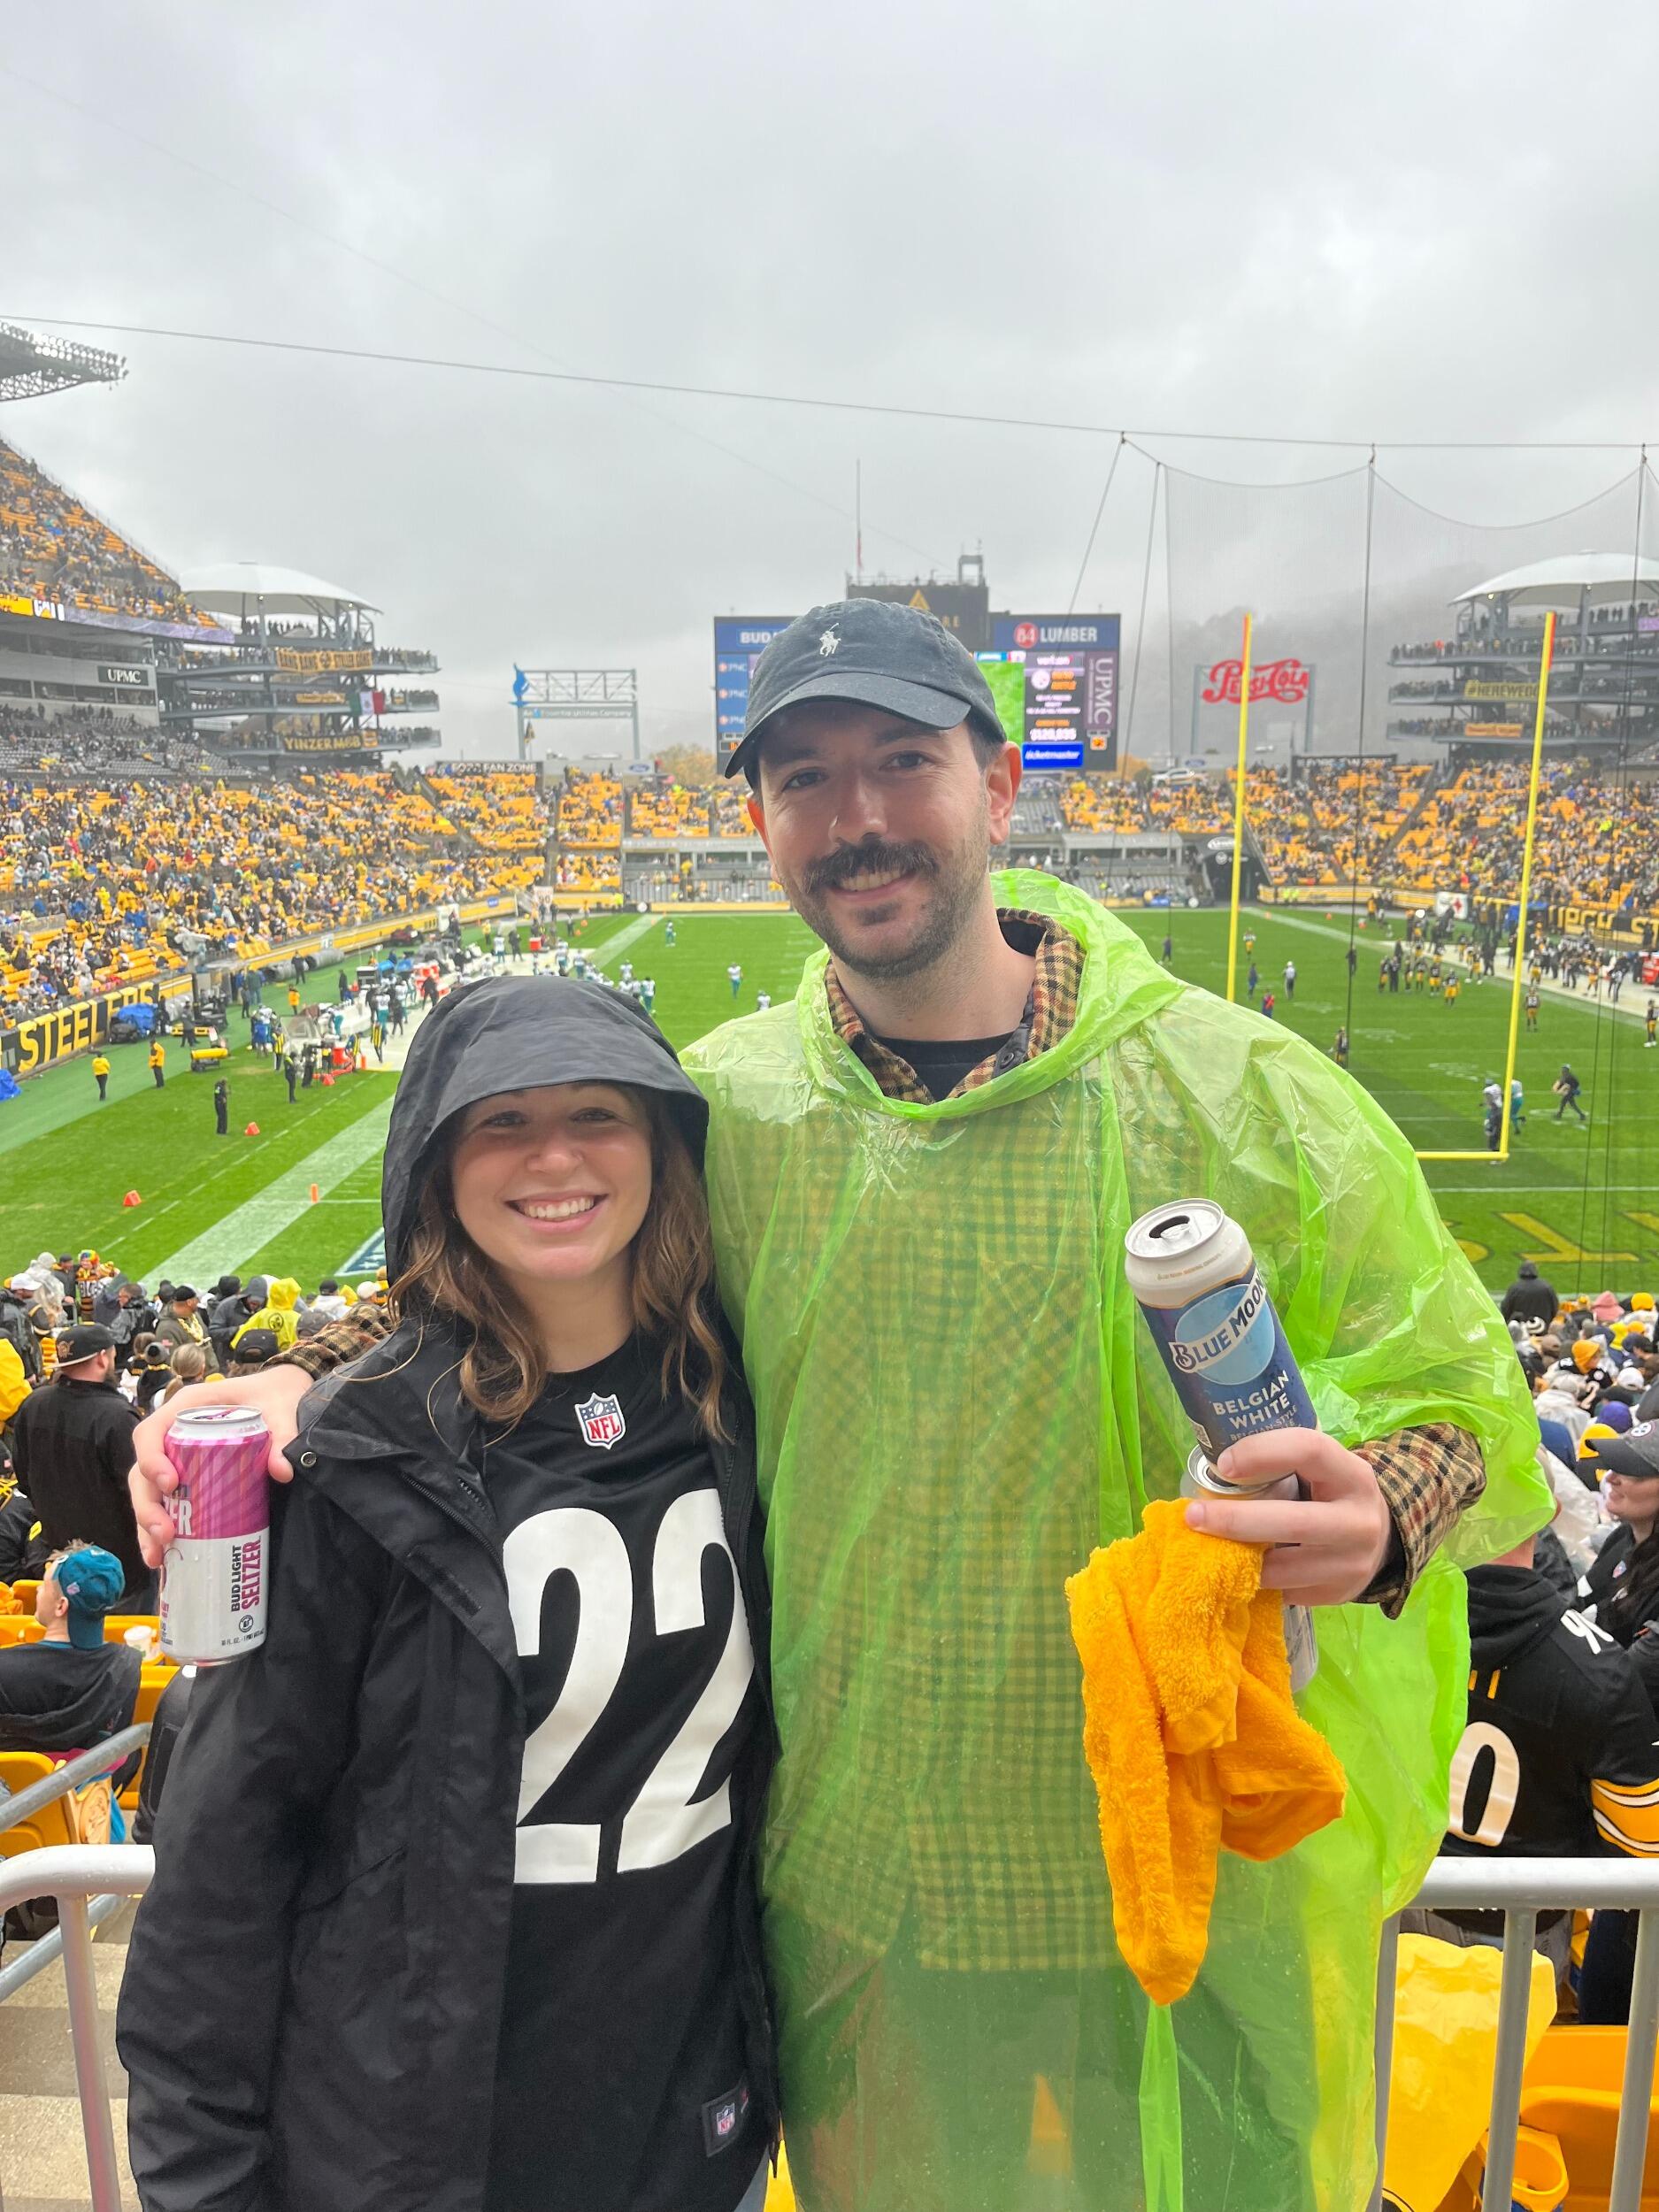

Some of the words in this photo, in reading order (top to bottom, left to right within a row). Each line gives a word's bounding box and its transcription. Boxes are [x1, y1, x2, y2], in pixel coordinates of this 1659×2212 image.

[1017, 629, 1035, 643] 84
[1040, 626, 1098, 643] LUMBER
[107, 668, 142, 684] UPMC
[1094, 657, 1114, 725] UPMC
[284, 736, 333, 751] YINZER
[1174, 1333, 1232, 1371] BLUE
[1233, 1274, 1264, 1339] MOON
[1212, 1371, 1289, 1417] BELGIAN
[1228, 1392, 1291, 1431] WHITE
[587, 1414, 620, 1440] NFL
[232, 1545, 242, 1583] LIGHT
[242, 1540, 261, 1610] SELTZER
[230, 1585, 241, 1612] BUD
[503, 1487, 755, 1884] 22
